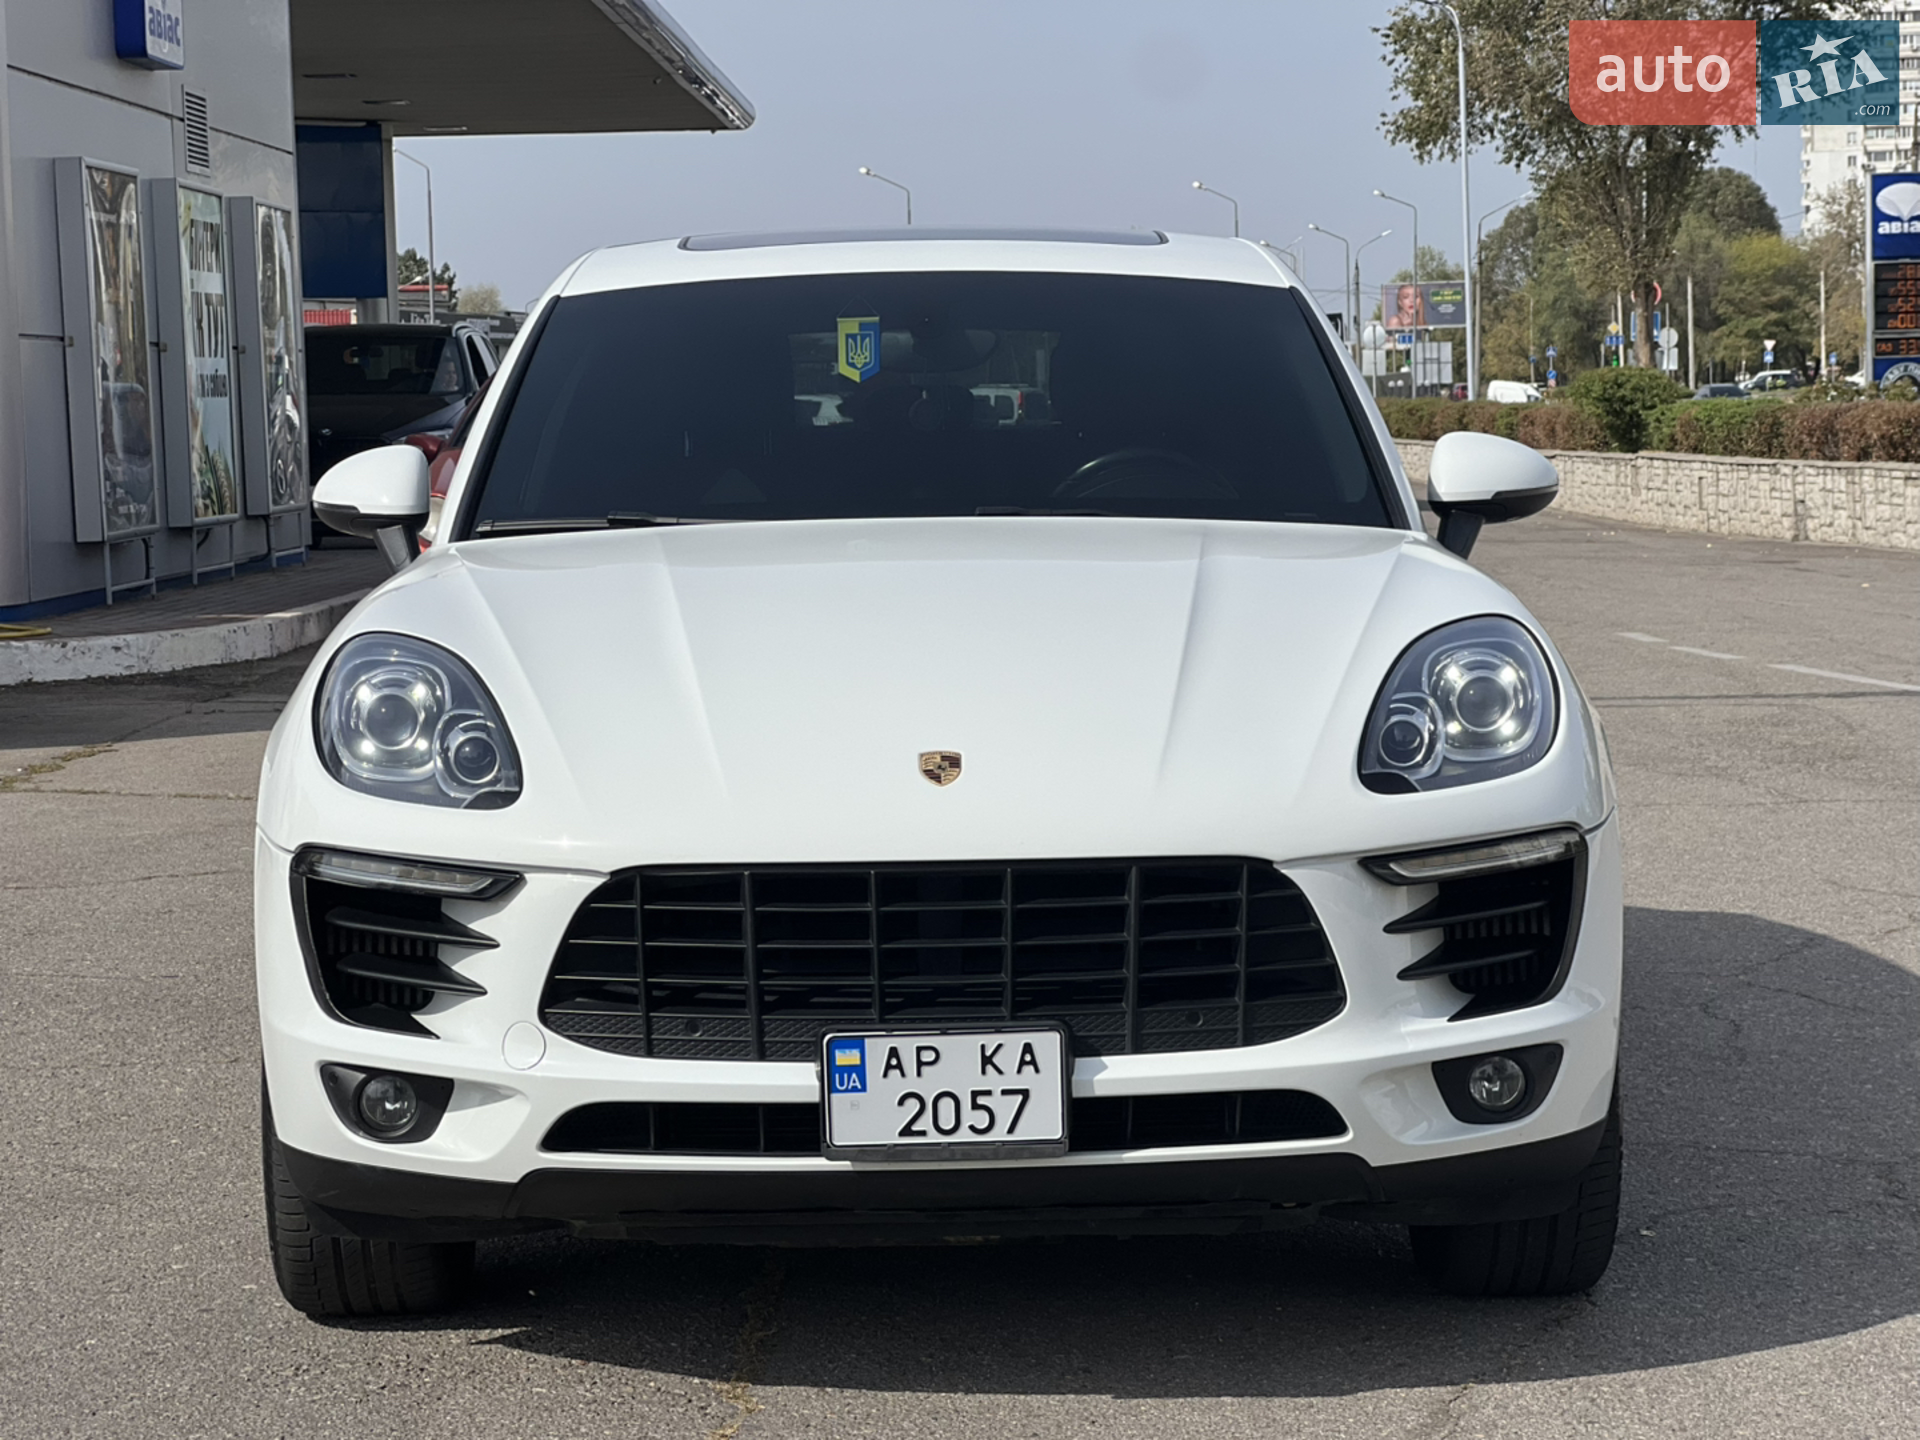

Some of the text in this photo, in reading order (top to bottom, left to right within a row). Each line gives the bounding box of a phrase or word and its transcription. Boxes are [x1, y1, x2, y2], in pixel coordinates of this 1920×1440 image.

[882, 1041, 1041, 1079] AP KA
[835, 1073, 862, 1091] UA
[896, 1088, 1031, 1138] 2057
